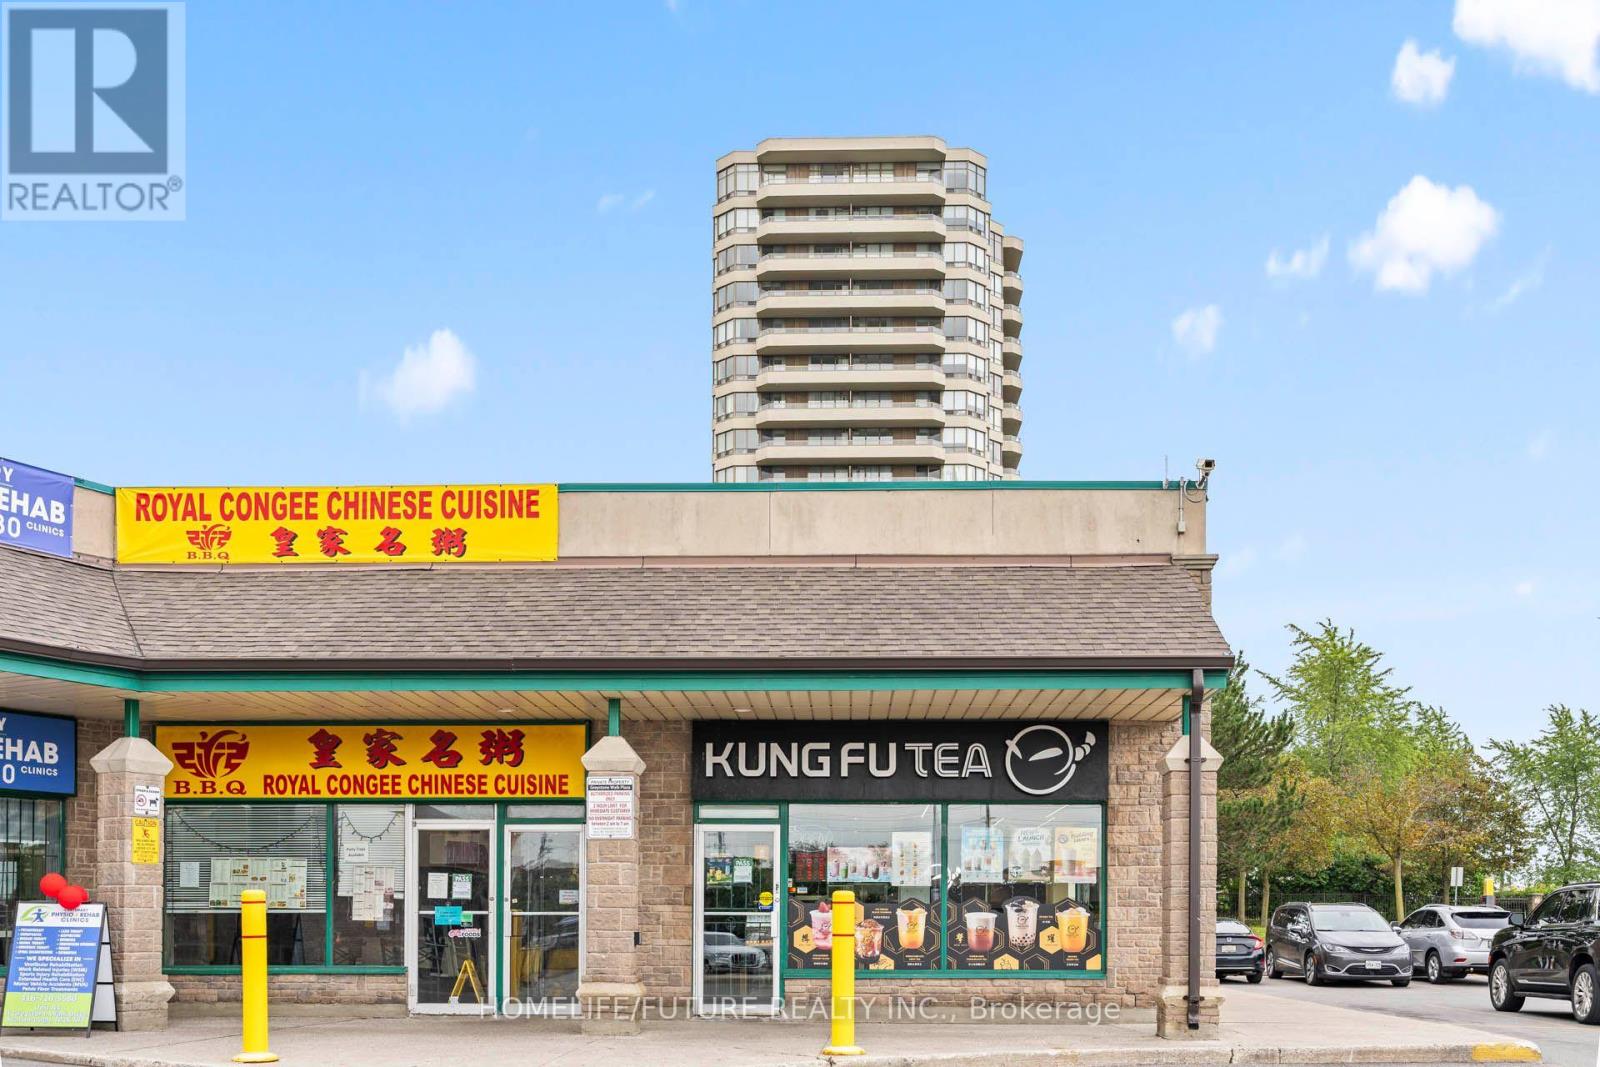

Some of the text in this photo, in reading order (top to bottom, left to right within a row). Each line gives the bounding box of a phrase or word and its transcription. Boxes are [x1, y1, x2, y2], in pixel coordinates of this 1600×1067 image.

[135, 489, 540, 522] ROYAL CONGEE CHINESE CUISINE
[26, 521, 65, 537] CLINICS
[270, 525, 467, 558] 皇家名粥
[187, 551, 230, 560] B.B.Q
[307, 728, 526, 769] 皇家名粥
[705, 742, 993, 778] KUNG FU TEA
[20, 765, 58, 777] CLINICS
[173, 780, 247, 795] B.B.Q
[263, 774, 569, 795] ROYAL CONGEE CHINESE CUISINE
